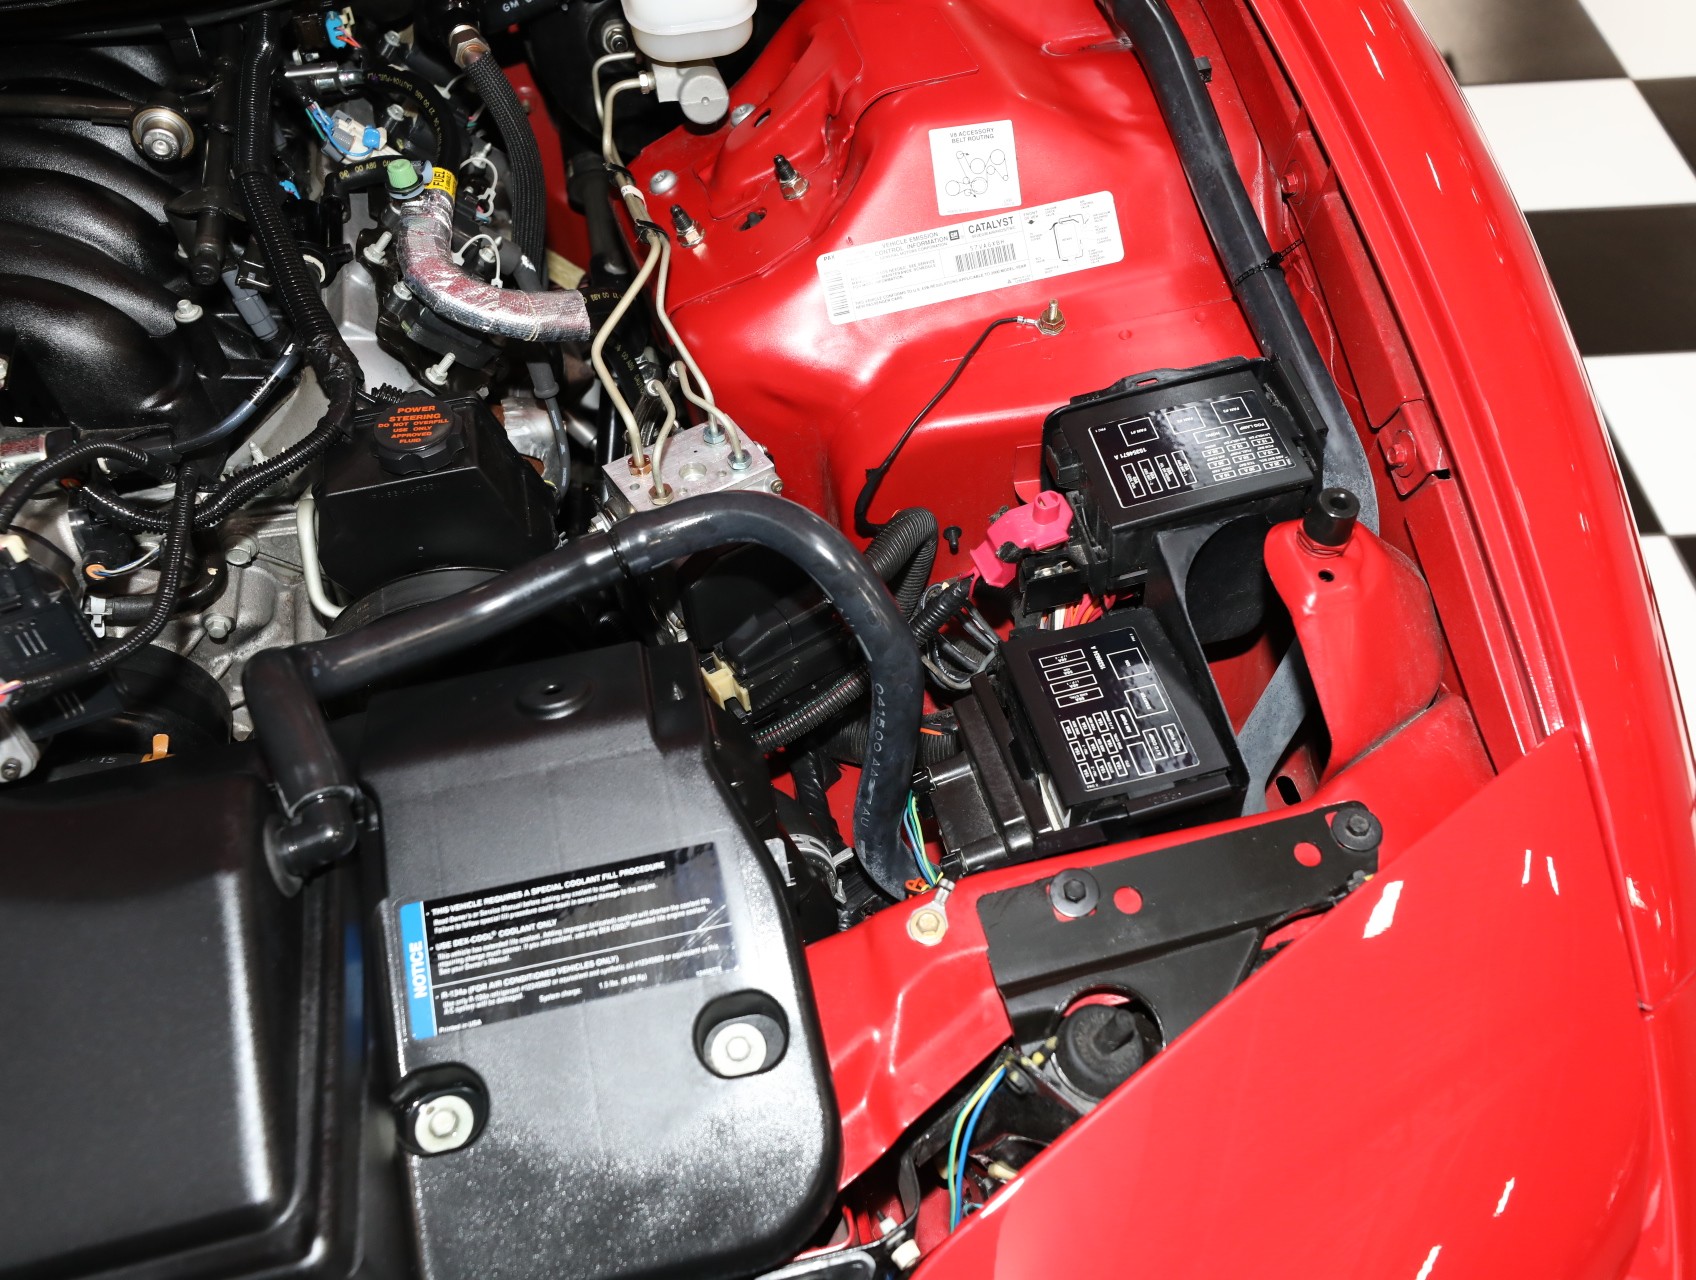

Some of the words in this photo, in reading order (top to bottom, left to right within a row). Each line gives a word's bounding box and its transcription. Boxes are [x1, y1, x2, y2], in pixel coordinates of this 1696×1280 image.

[502, 0, 520, 13] GM
[951, 136, 966, 144] BELT
[967, 133, 994, 141] ROUTING
[958, 127, 994, 136] ACCESSORY
[433, 170, 446, 186] FUEL
[968, 216, 1013, 234] CATALYST
[874, 246, 903, 256] CONTROL
[906, 236, 948, 248] INFORMATION
[881, 238, 907, 248] VEHICLE
[909, 232, 938, 243] EMISSION
[389, 413, 441, 422] STEERING
[397, 405, 436, 414] POWER
[413, 418, 449, 426] OVERFILL
[391, 431, 433, 439] APPROVED
[1119, 713, 1129, 726] PUMP
[1148, 733, 1157, 746] COMP
[1167, 728, 1176, 741] PUMP
[1173, 739, 1181, 752] FUEL
[432, 905, 450, 915] THIS
[449, 899, 482, 912] VEHICLE
[483, 891, 523, 905] REQUIRES
[523, 889, 531, 897] A
[530, 883, 563, 895] SPECIAL
[564, 874, 600, 888] COOLANT
[601, 871, 618, 881] FILL
[619, 861, 665, 876] PROCEDURE
[479, 914, 501, 925] special
[509, 907, 538, 919] procedure
[537, 903, 554, 913] could
[577, 895, 598, 904] serious
[597, 890, 621, 900] damage
[626, 886, 637, 894] the
[522, 898, 541, 908] before
[540, 894, 561, 904] adding
[560, 892, 571, 900] any
[570, 887, 593, 897] coolant
[617, 913, 638, 924] coolant
[679, 899, 701, 909] coolant
[435, 940, 452, 951] USE
[498, 923, 535, 937] COOLANT
[536, 919, 557, 929] ONLY
[408, 940, 428, 999] NOTICE
[467, 982, 488, 994] (FOR
[488, 979, 503, 989] AIR
[503, 968, 557, 986] CONDITIONED
[556, 960, 595, 974] VEHICLES
[595, 955, 619, 966] ONLY)
[558, 971, 589, 984] equivalent
[588, 968, 600, 977] and
[599, 964, 626, 975] synthetic
[538, 992, 561, 1003] System
[438, 1025, 461, 1034] Printed
[468, 1018, 483, 1028] USA
